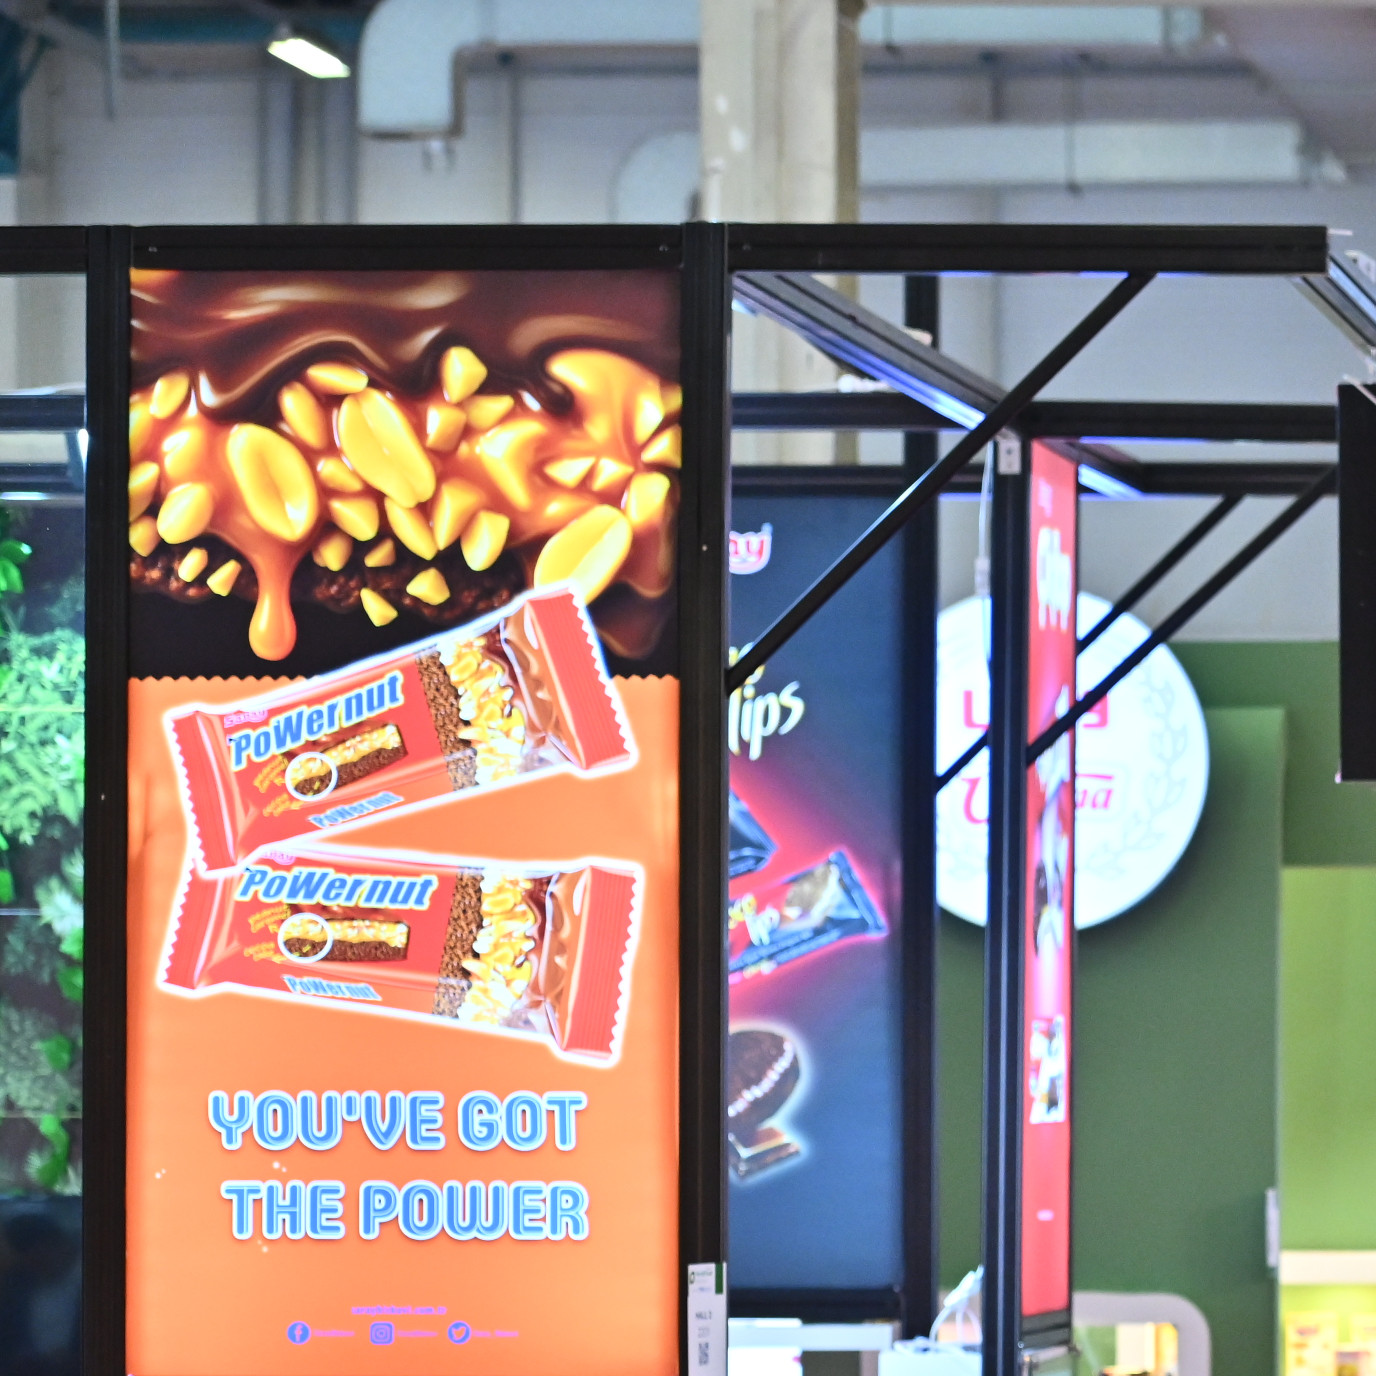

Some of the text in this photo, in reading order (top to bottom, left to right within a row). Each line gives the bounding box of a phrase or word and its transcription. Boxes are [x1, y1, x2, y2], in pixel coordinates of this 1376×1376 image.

[208, 1090, 588, 1152] YOU'VE GOT
[220, 1179, 589, 1241] THE POWER
